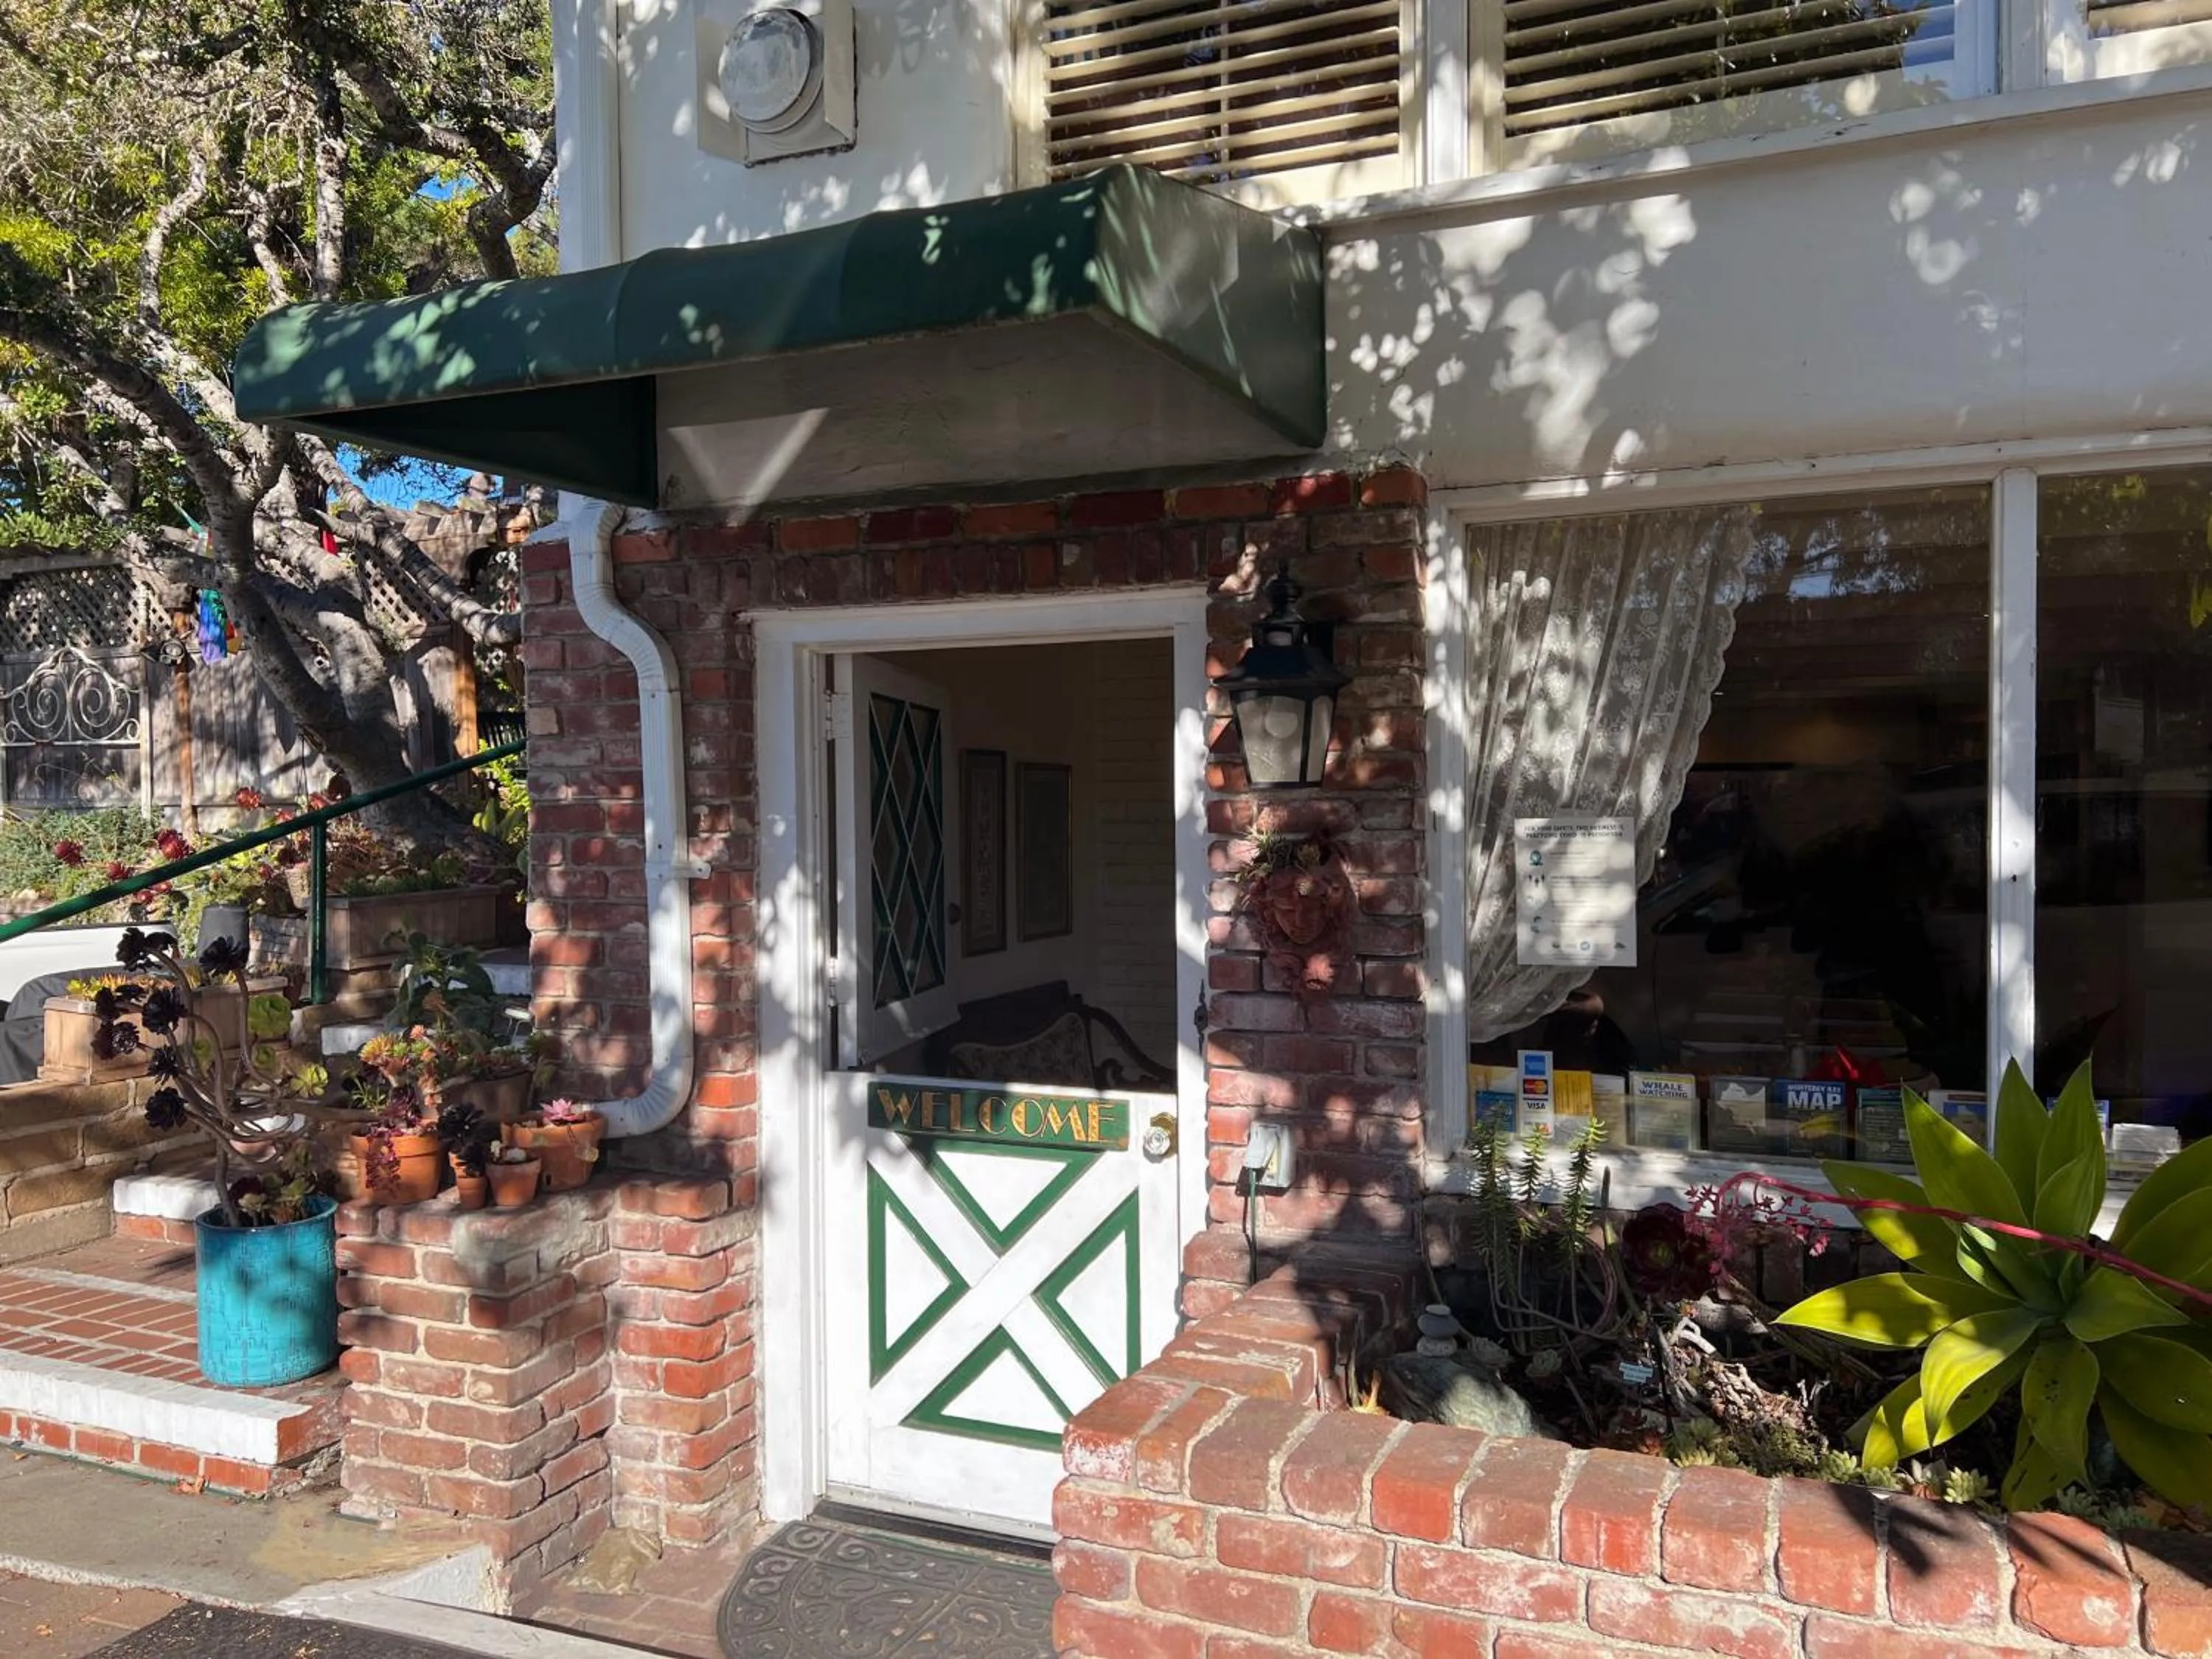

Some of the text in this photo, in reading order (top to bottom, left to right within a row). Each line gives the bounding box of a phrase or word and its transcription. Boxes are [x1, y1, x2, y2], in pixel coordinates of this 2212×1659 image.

[1639, 1089, 1688, 1099] WATCHING
[1642, 1081, 1684, 1092] WHALE
[1787, 1091, 1841, 1110] MAP
[877, 1088, 1116, 1142] WELCOME
